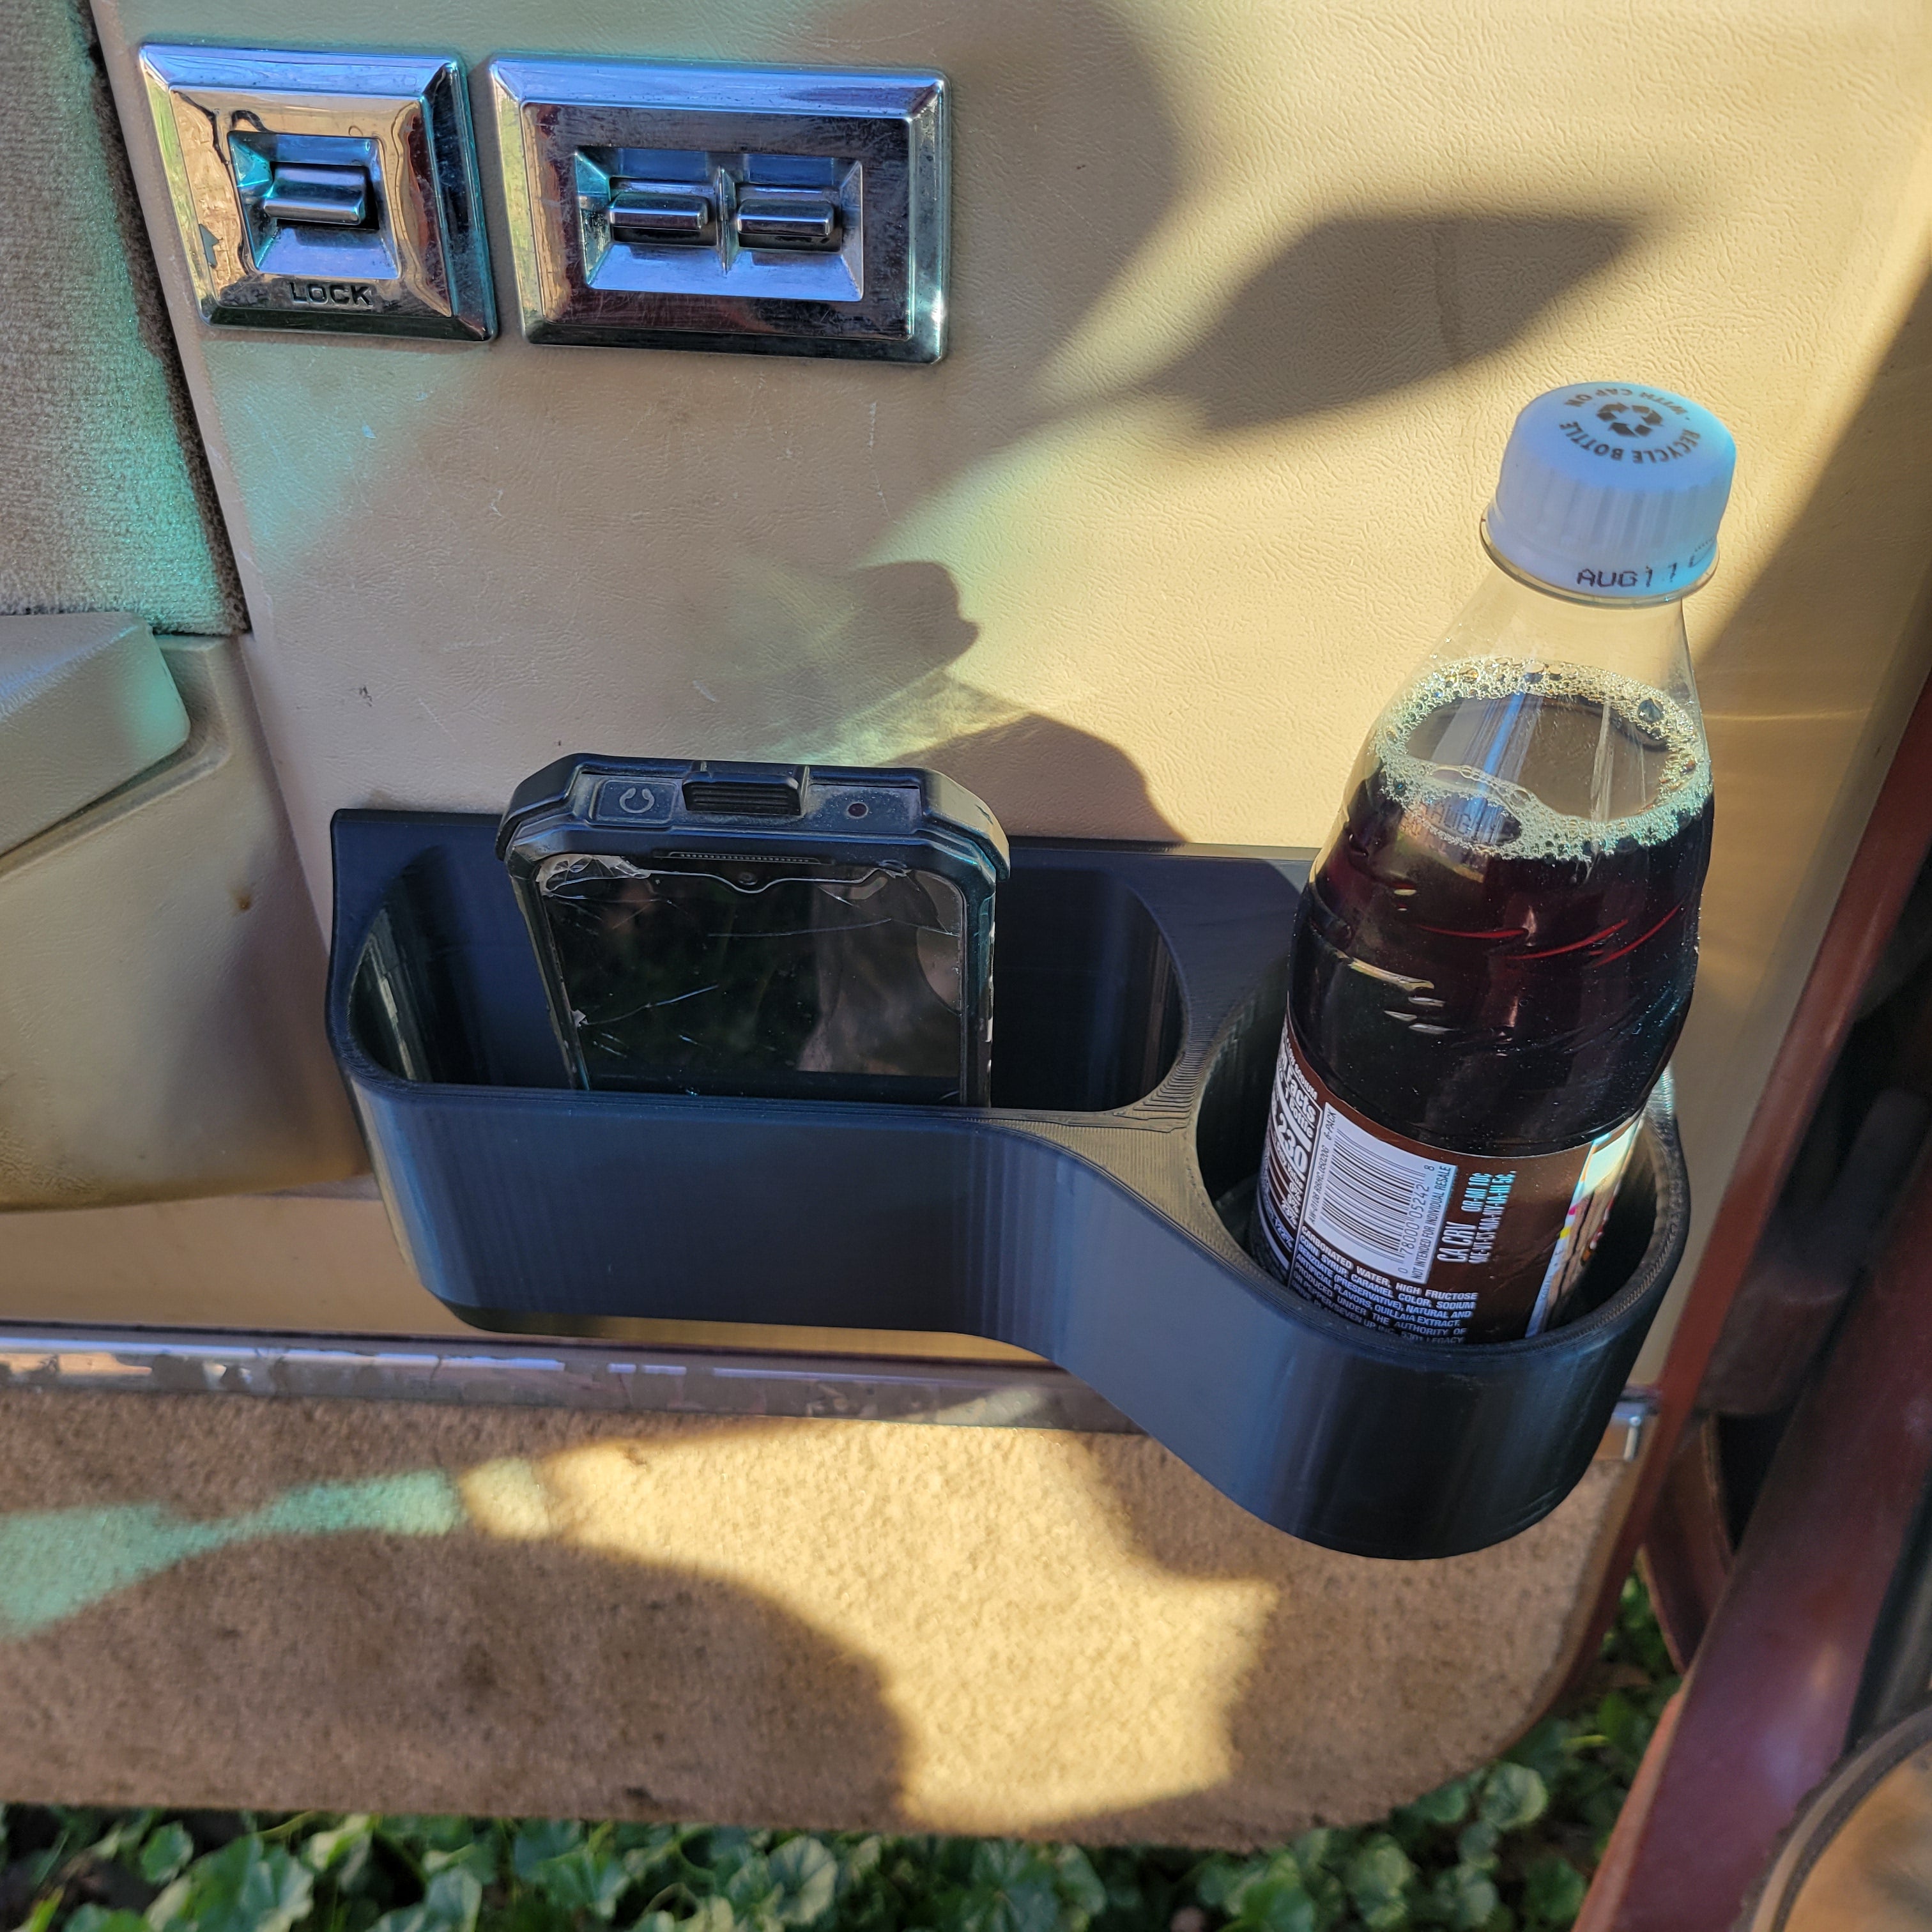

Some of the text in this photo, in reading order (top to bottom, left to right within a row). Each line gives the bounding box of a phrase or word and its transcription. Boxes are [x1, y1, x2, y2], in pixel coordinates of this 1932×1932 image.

[289, 282, 374, 306] LOCK
[1564, 388, 1688, 415] WITH CAP ON
[1558, 421, 1701, 464] RECYCLE BOTTLE
[1287, 1064, 1316, 1123] Facts
[1294, 1064, 1318, 1100] SODIUM
[1278, 1112, 1308, 1173] 230
[1324, 1109, 1337, 1140] 6-PACK
[1289, 1181, 1302, 1202] 0%
[1408, 1184, 1430, 1220] 05242
[1400, 1222, 1420, 1255] 78000
[1411, 1166, 1451, 1280] NOT INTENDED FOR INDIVIDUAL RESALE
[1442, 1221, 1477, 1246] CRV
[1300, 1234, 1320, 1257] CORN
[1351, 1273, 1394, 1298] CARAMEL
[1398, 1292, 1432, 1308] COLOR,
[1436, 1301, 1476, 1310] SODIUM
[1301, 1225, 1479, 1301] CARBONATED WATER, HIGH FRUCTOSE
[1438, 1247, 1469, 1263] CA
[1295, 1262, 1333, 1297] PRODUCED
[1337, 1296, 1367, 1316] UNDER
[1372, 1312, 1390, 1326] THE
[1395, 1321, 1448, 1336] AUTHORITY
[1296, 1253, 1333, 1288] ARTIFICIAL
[1333, 1283, 1373, 1310] FLAVORS,
[1374, 1304, 1416, 1321] QUILLAIA
[1416, 1315, 1460, 1327] EXTRACT.
[1298, 1243, 1334, 1278] BENZOATE
[1333, 1274, 1404, 1312] (PRESERVATIVE),
[1406, 1304, 1449, 1319] NATURAL
[1450, 1310, 1473, 1319] AND
